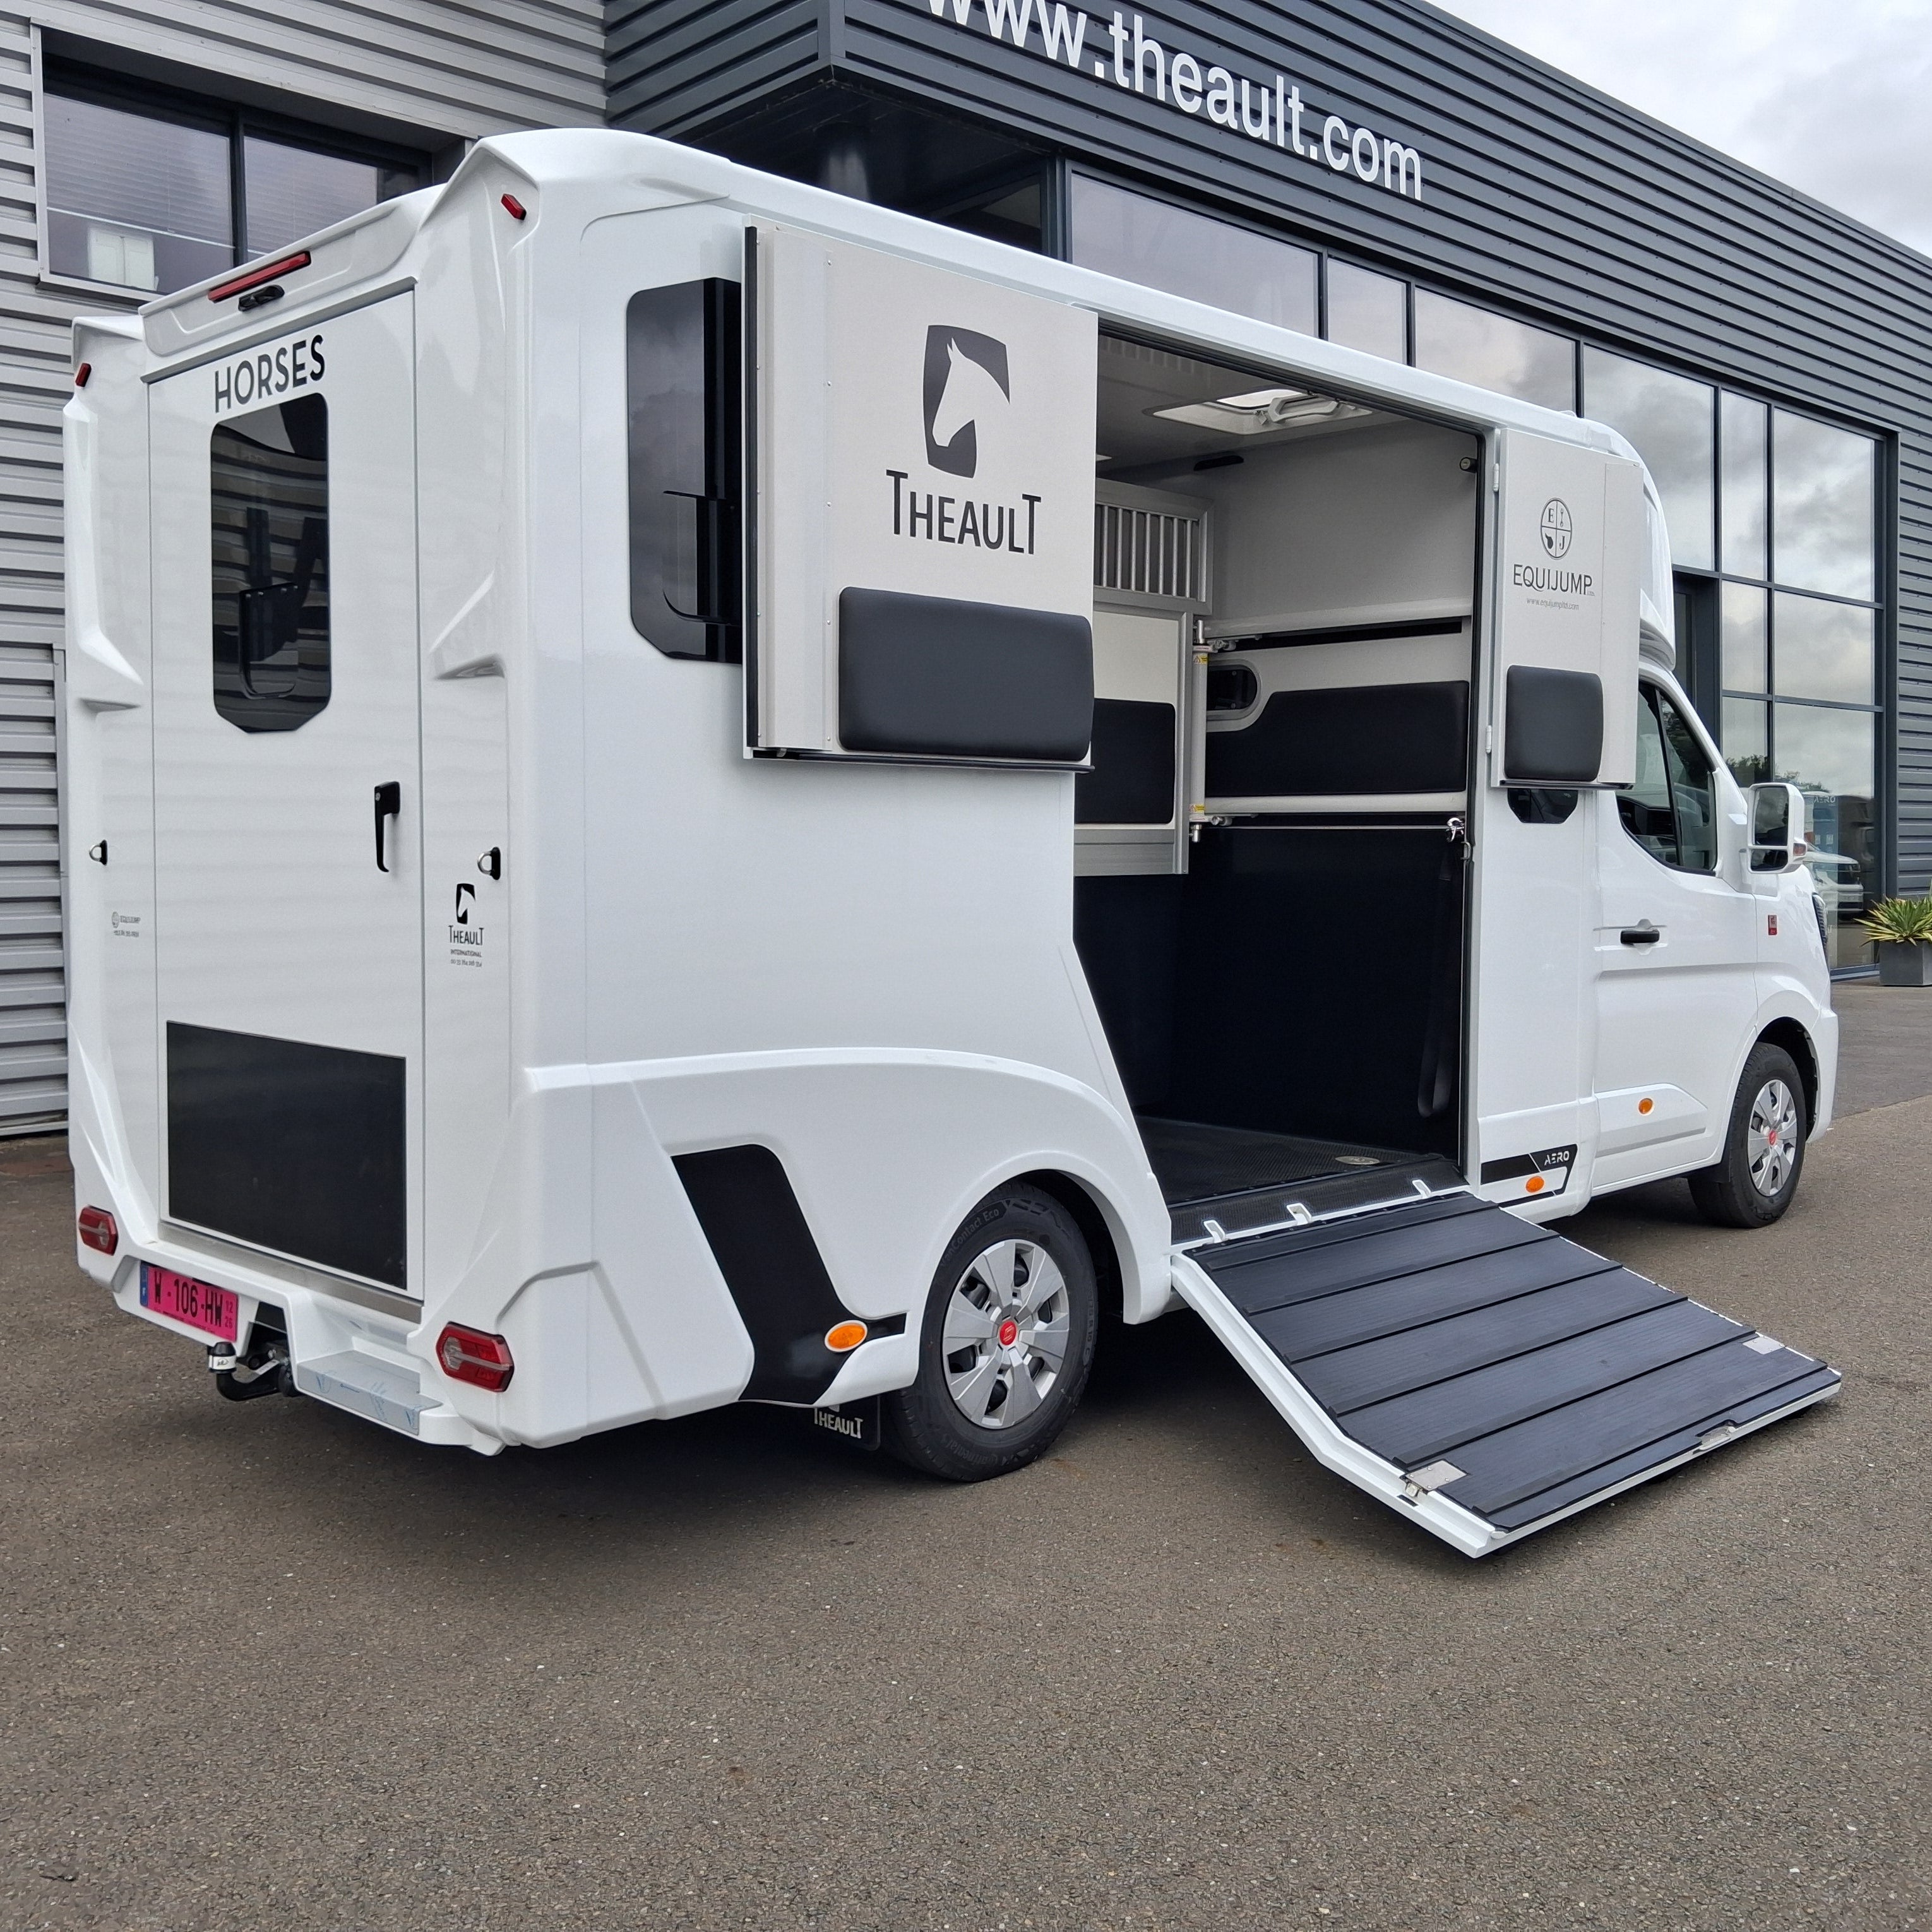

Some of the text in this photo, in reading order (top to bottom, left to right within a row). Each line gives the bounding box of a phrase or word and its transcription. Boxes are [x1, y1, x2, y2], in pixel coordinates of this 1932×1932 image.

[215, 334, 325, 413] HORSES
[1547, 508, 1554, 523] E
[1559, 535, 1565, 550] J
[1513, 563, 1592, 595] EQUIJUMP
[1544, 1150, 1570, 1166] AERO
[982, 1208, 999, 1222] Eco
